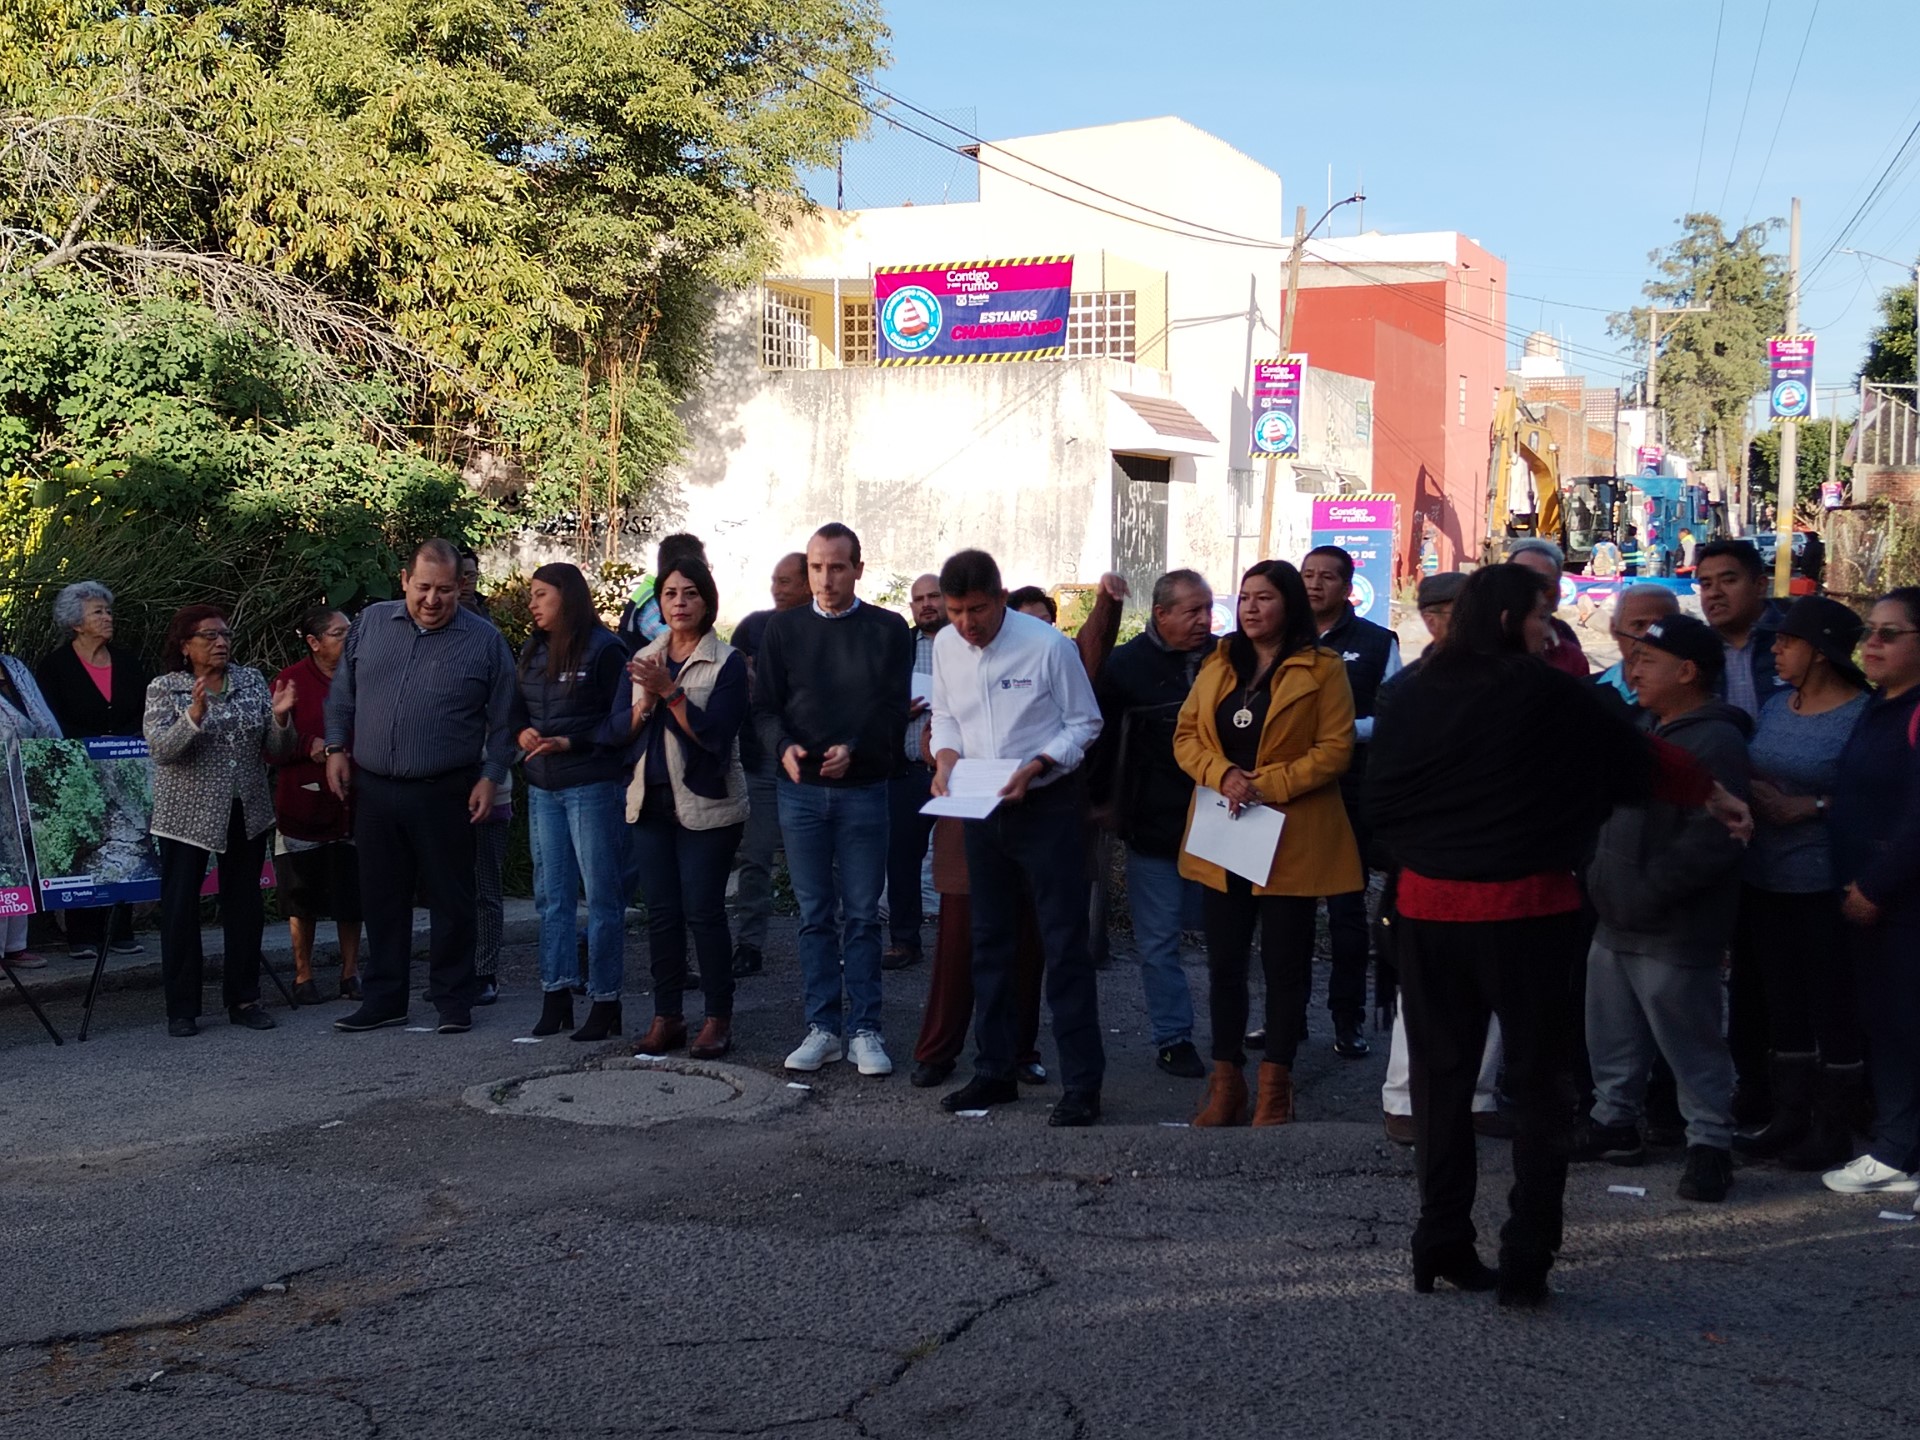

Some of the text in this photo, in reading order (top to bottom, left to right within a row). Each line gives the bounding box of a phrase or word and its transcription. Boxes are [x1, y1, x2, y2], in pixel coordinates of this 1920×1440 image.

[946, 270, 990, 283] Contigo
[962, 281, 999, 292] rumbo
[979, 310, 1038, 323] ESTAMOS
[951, 318, 1063, 341] CHAMBEANDO
[1329, 507, 1368, 518] Contigo
[1342, 514, 1377, 523] rumbo
